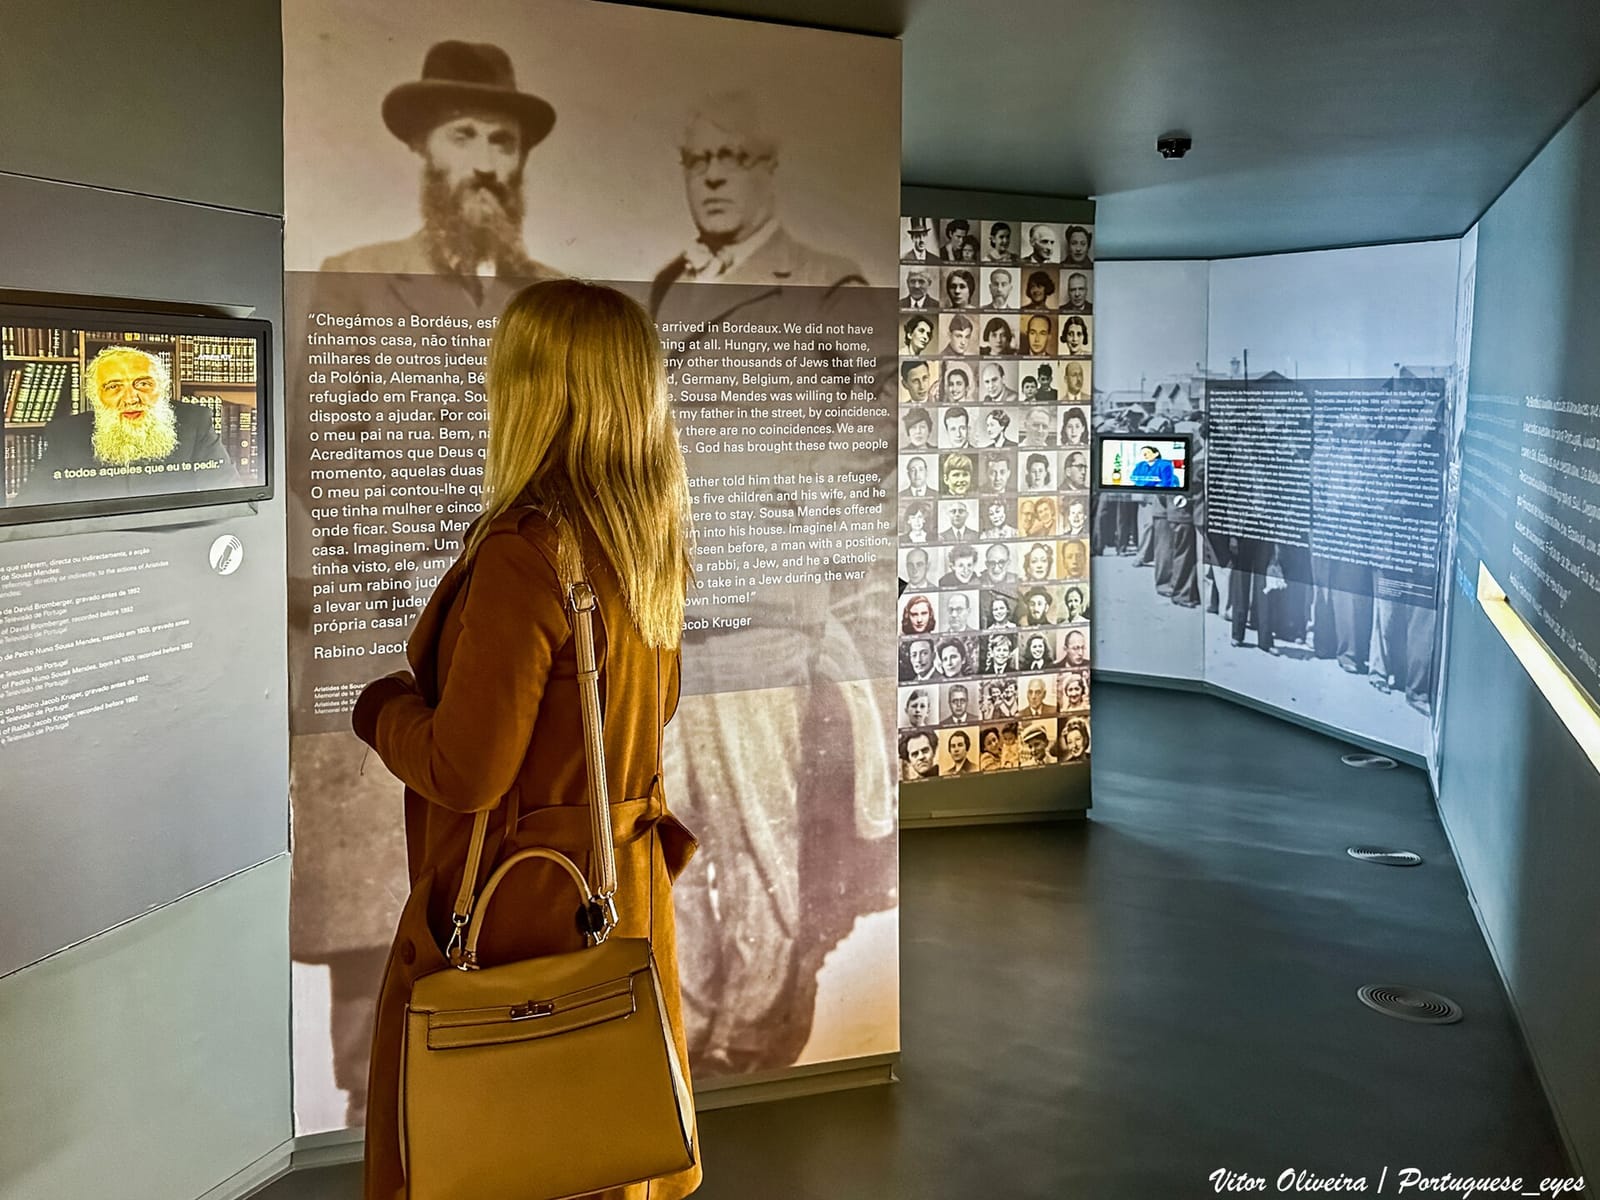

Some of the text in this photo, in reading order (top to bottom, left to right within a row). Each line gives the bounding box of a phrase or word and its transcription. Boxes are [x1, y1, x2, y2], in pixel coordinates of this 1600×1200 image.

[397, 317, 406, 327] a
[410, 315, 472, 330] Bordéus,
[662, 321, 873, 335] arrived in Bordeaux. We did not have
[307, 332, 447, 348] tínhamos casa, não
[689, 339, 870, 353] at all. Hungry, we had no home,
[309, 352, 371, 365] milhares
[374, 352, 392, 365] de
[396, 354, 441, 365] outros
[662, 356, 876, 371] any other thousands of Jews that fled
[308, 371, 464, 386] da Polónia, Alemanha,
[681, 372, 875, 387] Germany, Belgium, and came into
[309, 390, 460, 406] refugiado em França.
[680, 389, 877, 403] Sousa Mendes was willing to help.
[309, 409, 464, 425] disposto a ajudar. Por
[679, 406, 890, 421] my father in the street, by coincidence.
[310, 427, 474, 443] o meu pai na rua. Bem,
[310, 446, 474, 461] Acreditamos que Deus
[695, 438, 888, 454] God has brought these two people
[53, 470, 62, 479] a
[64, 467, 97, 478] todos
[99, 464, 142, 476] aqueles
[144, 464, 165, 475] que
[166, 463, 180, 472] eu
[180, 462, 193, 472] te
[311, 464, 484, 480] momento, aquelas duas
[311, 486, 323, 499] O
[327, 488, 360, 498] meu
[364, 484, 386, 500] pai
[390, 483, 466, 497] contou-lhe
[311, 501, 482, 521] que tinha mulher e cinco
[312, 521, 436, 537] onde ficar. Sousa
[312, 538, 459, 556] casa. Imaginem. Um
[312, 558, 445, 575] tinha visto, ele, um
[313, 578, 412, 597] pai um rabino
[313, 604, 321, 614] a
[326, 600, 362, 613] levar
[365, 600, 388, 610] um
[314, 617, 366, 635] própria
[712, 617, 752, 629] Kruger
[314, 645, 365, 659] Rabino
